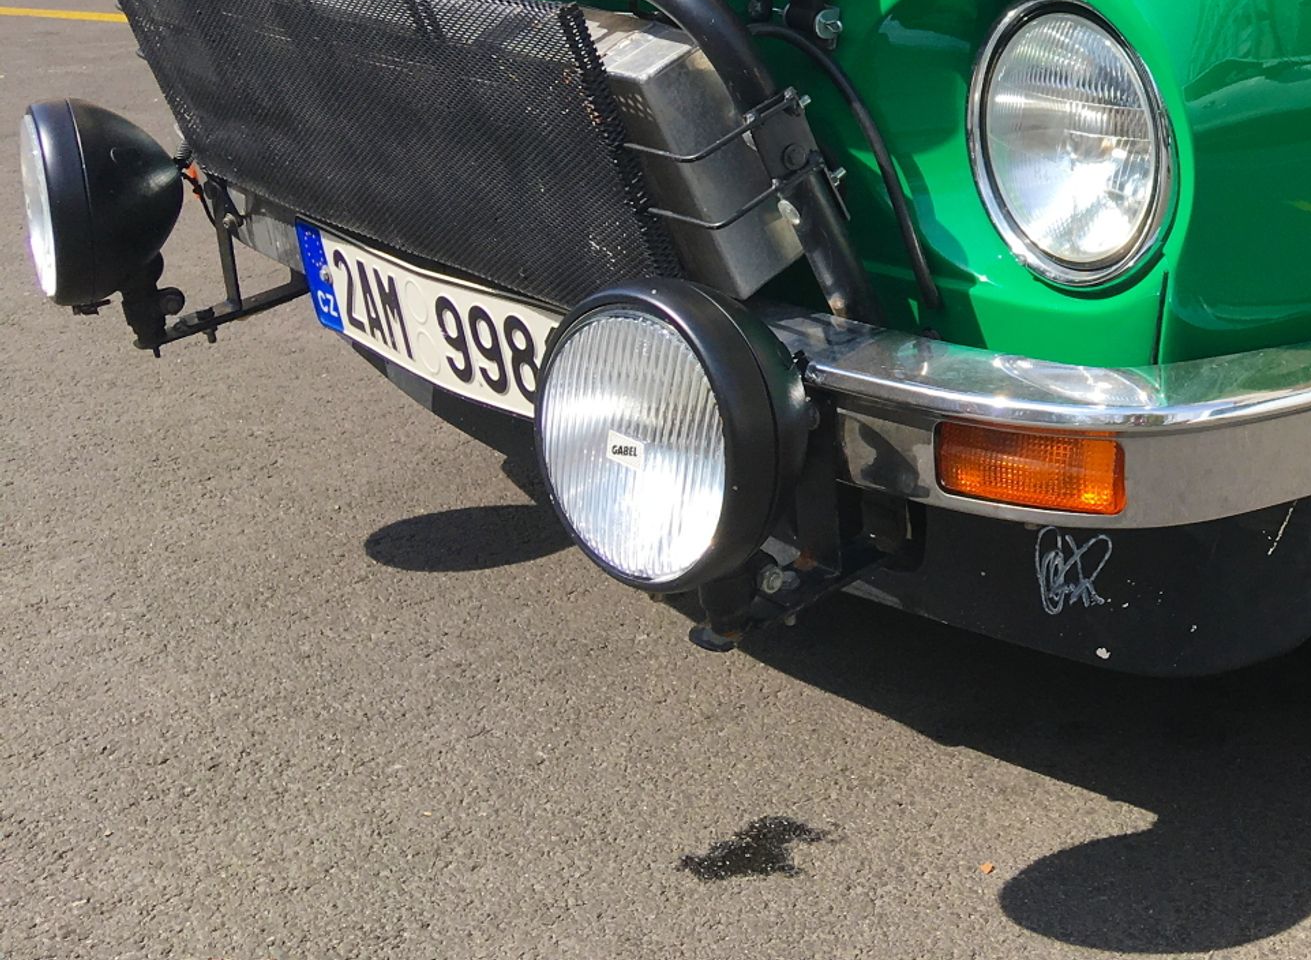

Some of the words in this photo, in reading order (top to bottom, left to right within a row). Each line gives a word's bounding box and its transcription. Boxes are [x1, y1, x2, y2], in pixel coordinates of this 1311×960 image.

[317, 291, 339, 318] CZ
[333, 249, 414, 361] 2AM
[435, 295, 558, 404] 998
[612, 445, 638, 457] GABEL
